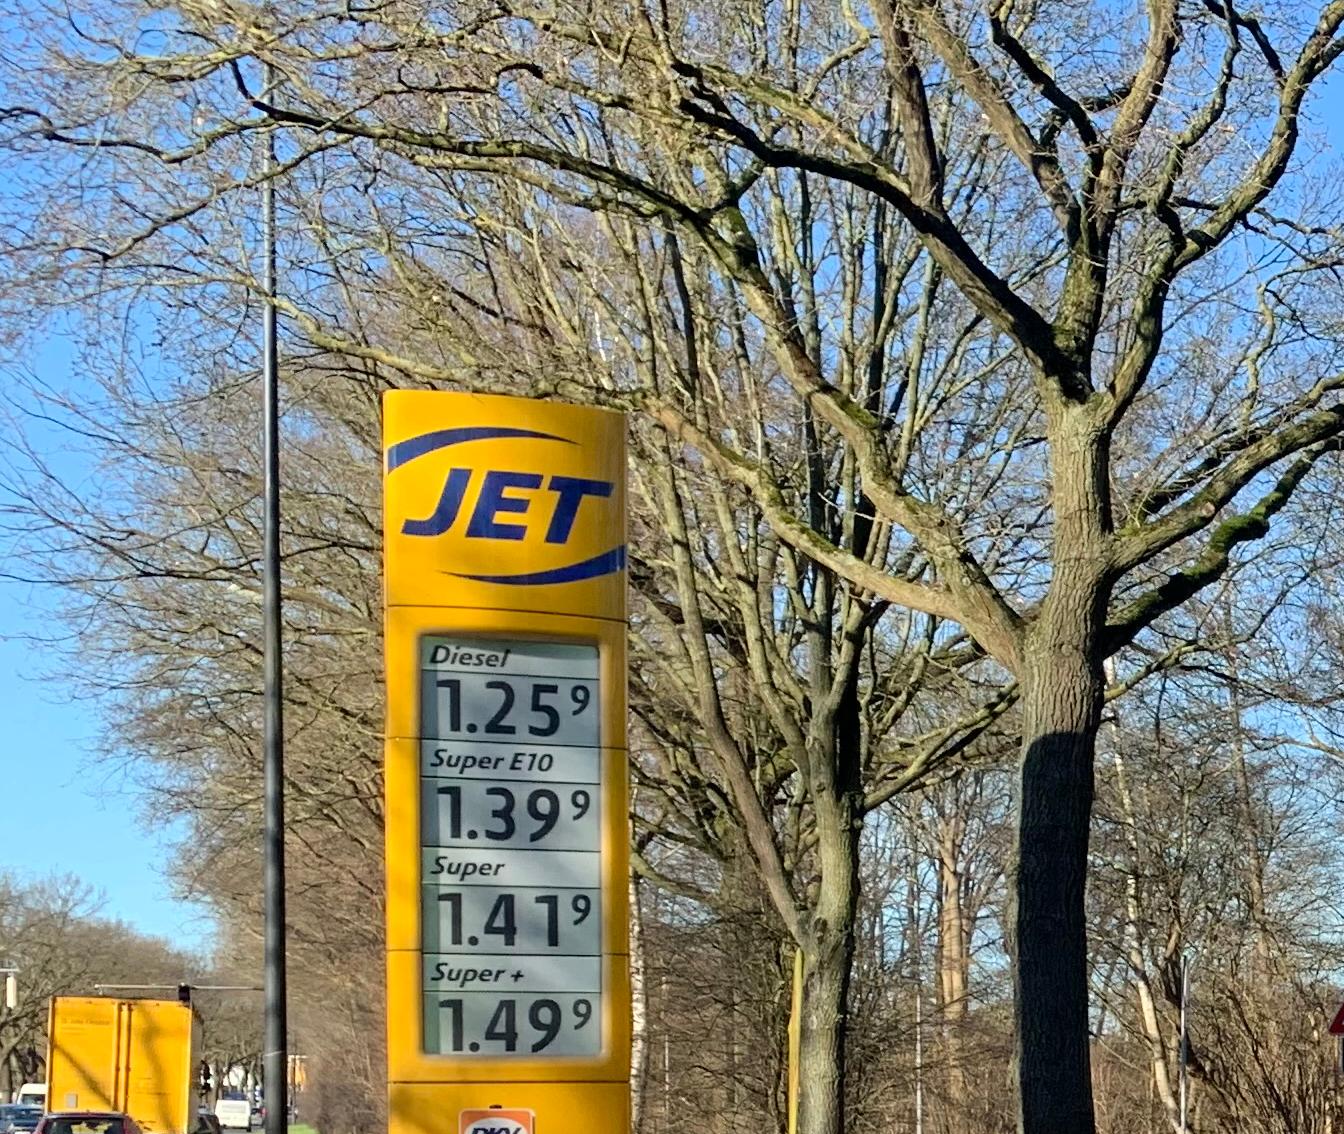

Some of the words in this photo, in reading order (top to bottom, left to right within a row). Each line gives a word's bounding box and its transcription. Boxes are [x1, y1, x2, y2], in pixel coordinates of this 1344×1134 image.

[401, 468, 614, 545] JET
[430, 645, 511, 667] Diesel
[436, 679, 590, 737] 1.259
[430, 749, 504, 774] Super
[509, 753, 553, 772] E10
[436, 786, 591, 842] 1.399
[430, 856, 505, 881] Super
[437, 892, 591, 947] 1.419
[431, 962, 506, 988] Super
[511, 970, 524, 982] +
[438, 998, 592, 1053] 1.499
